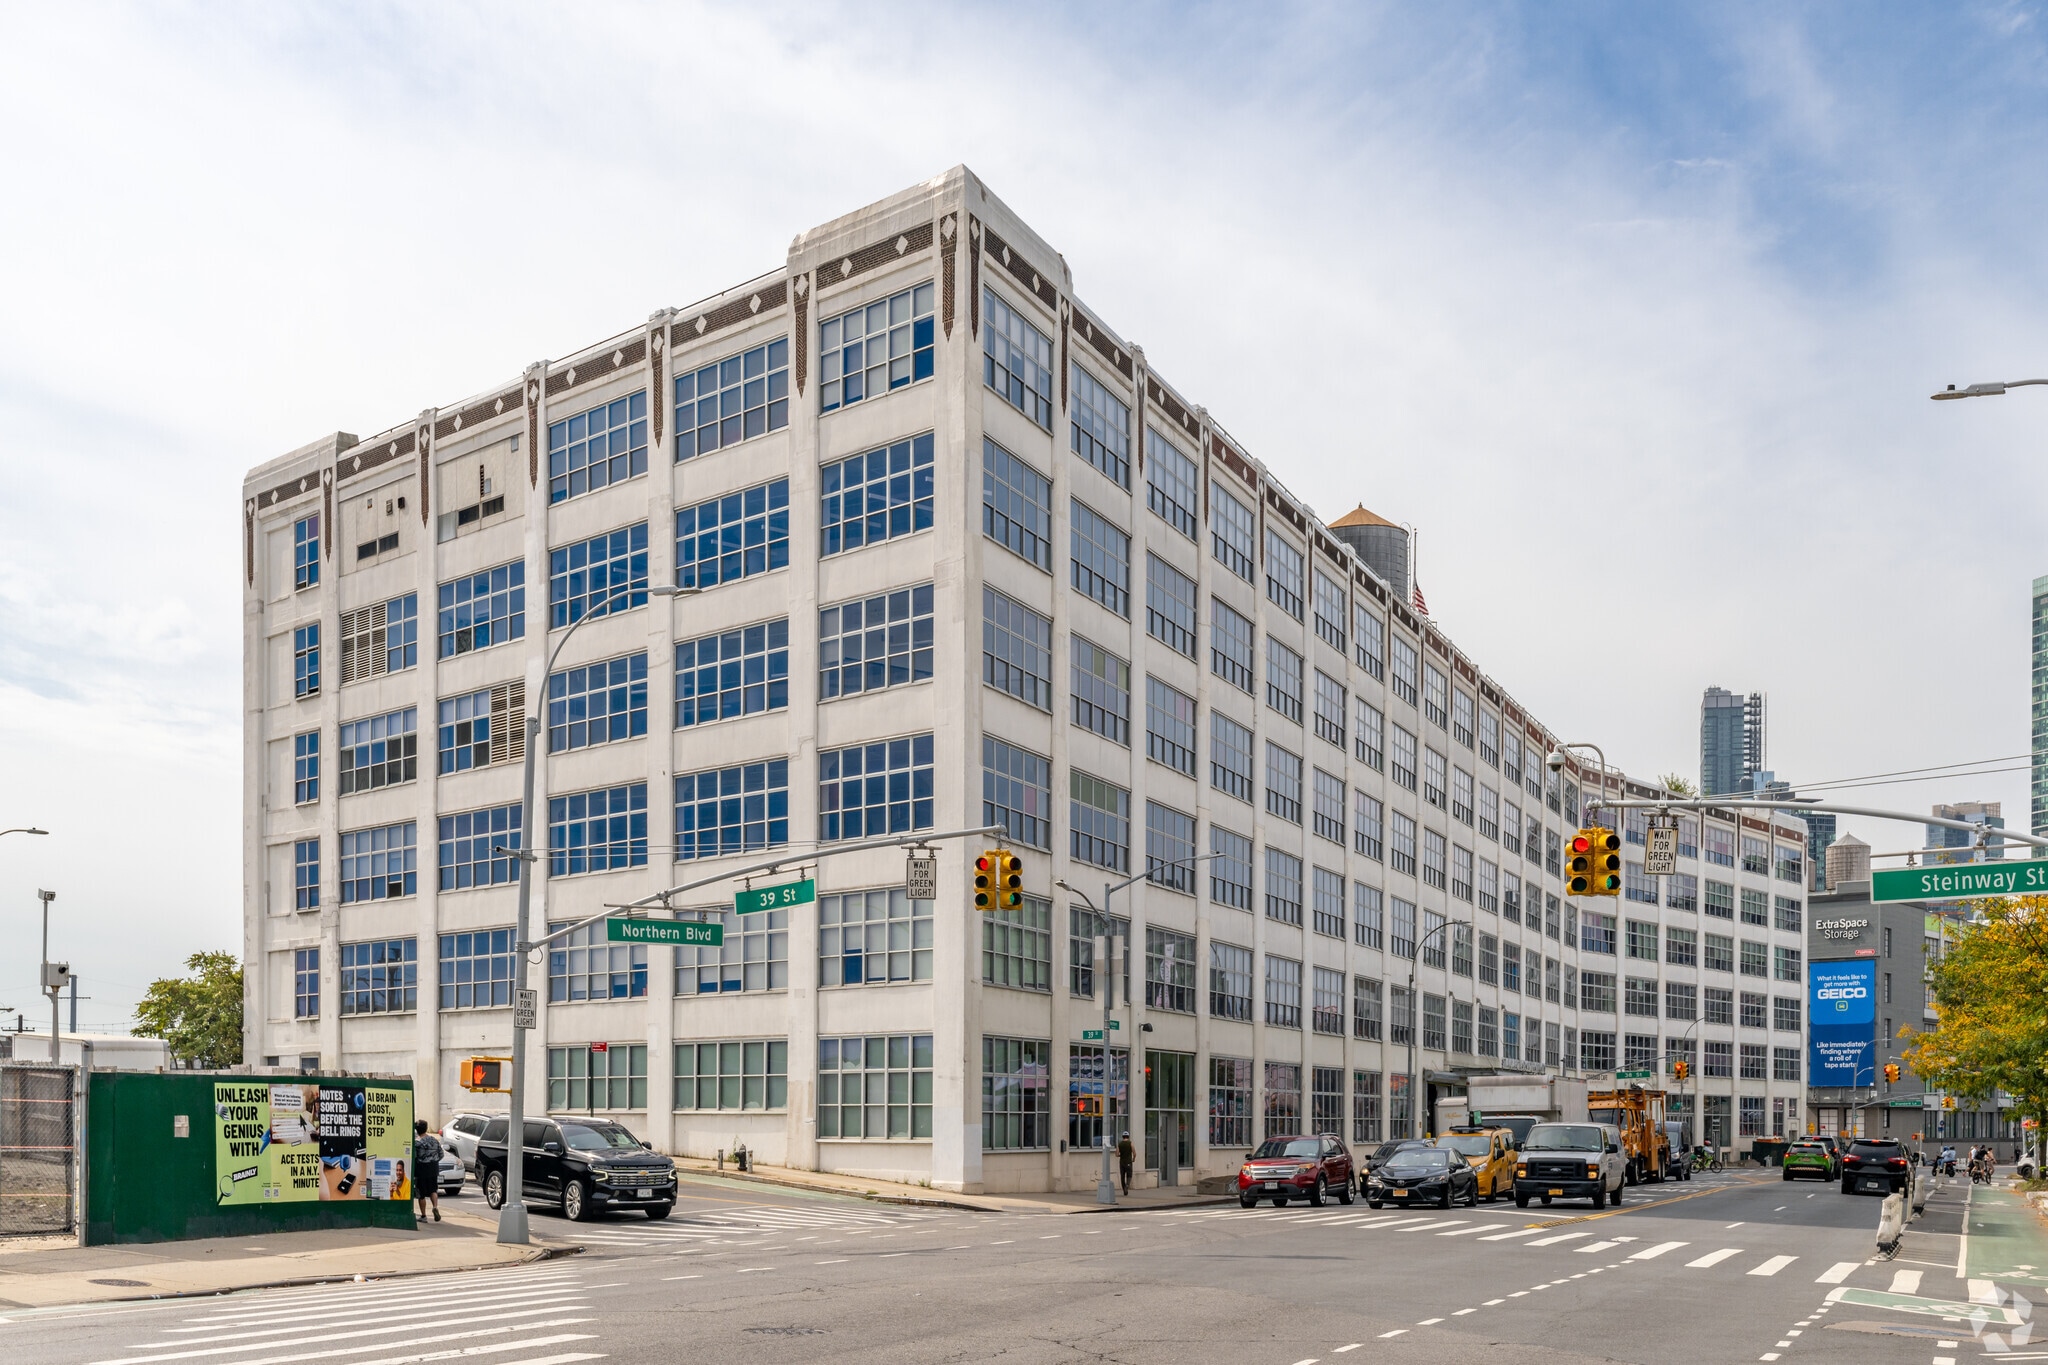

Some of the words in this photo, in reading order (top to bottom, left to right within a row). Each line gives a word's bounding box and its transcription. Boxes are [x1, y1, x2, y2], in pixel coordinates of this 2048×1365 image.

[1654, 830, 1672, 840] WAIT
[1654, 841, 1670, 850] FOR
[1648, 852, 1674, 860] GREEN
[913, 861, 930, 869] WAIT
[1648, 862, 1672, 872] LIGHT
[1922, 872, 2016, 892] Steinway
[2026, 868, 2046, 886] St
[760, 892, 775, 907] 39
[783, 888, 796, 902] St
[910, 888, 932, 896] LIGHT
[622, 924, 680, 940] Northern
[686, 926, 712, 941] Blvd
[1824, 929, 1859, 940] Storage
[1818, 987, 1867, 999] GEICO
[516, 1009, 534, 1017] GREEN
[216, 1088, 268, 1103] UNLEASH
[320, 1090, 343, 1100] NOTES
[367, 1092, 374, 1102] AI
[376, 1093, 396, 1103] BRAIN
[228, 1106, 258, 1120] YOUR
[320, 1102, 348, 1113] SORTED
[367, 1104, 391, 1115] BOOST,
[320, 1114, 348, 1124] BEFORE
[349, 1114, 363, 1125] THE
[368, 1116, 385, 1126] STEP
[386, 1116, 395, 1126] BY
[224, 1124, 264, 1139] GENIUS
[320, 1126, 338, 1136] BELL
[340, 1126, 361, 1137] RINGS
[368, 1127, 385, 1137] STEP
[230, 1142, 259, 1157] WITH
[281, 1154, 295, 1164] ACE
[297, 1154, 320, 1164] TESTS
[233, 1168, 257, 1181] BRAINLY
[291, 1166, 298, 1176] IN
[300, 1166, 305, 1176] A
[306, 1166, 319, 1176] N.Y.
[293, 1178, 319, 1188] MINUTE
